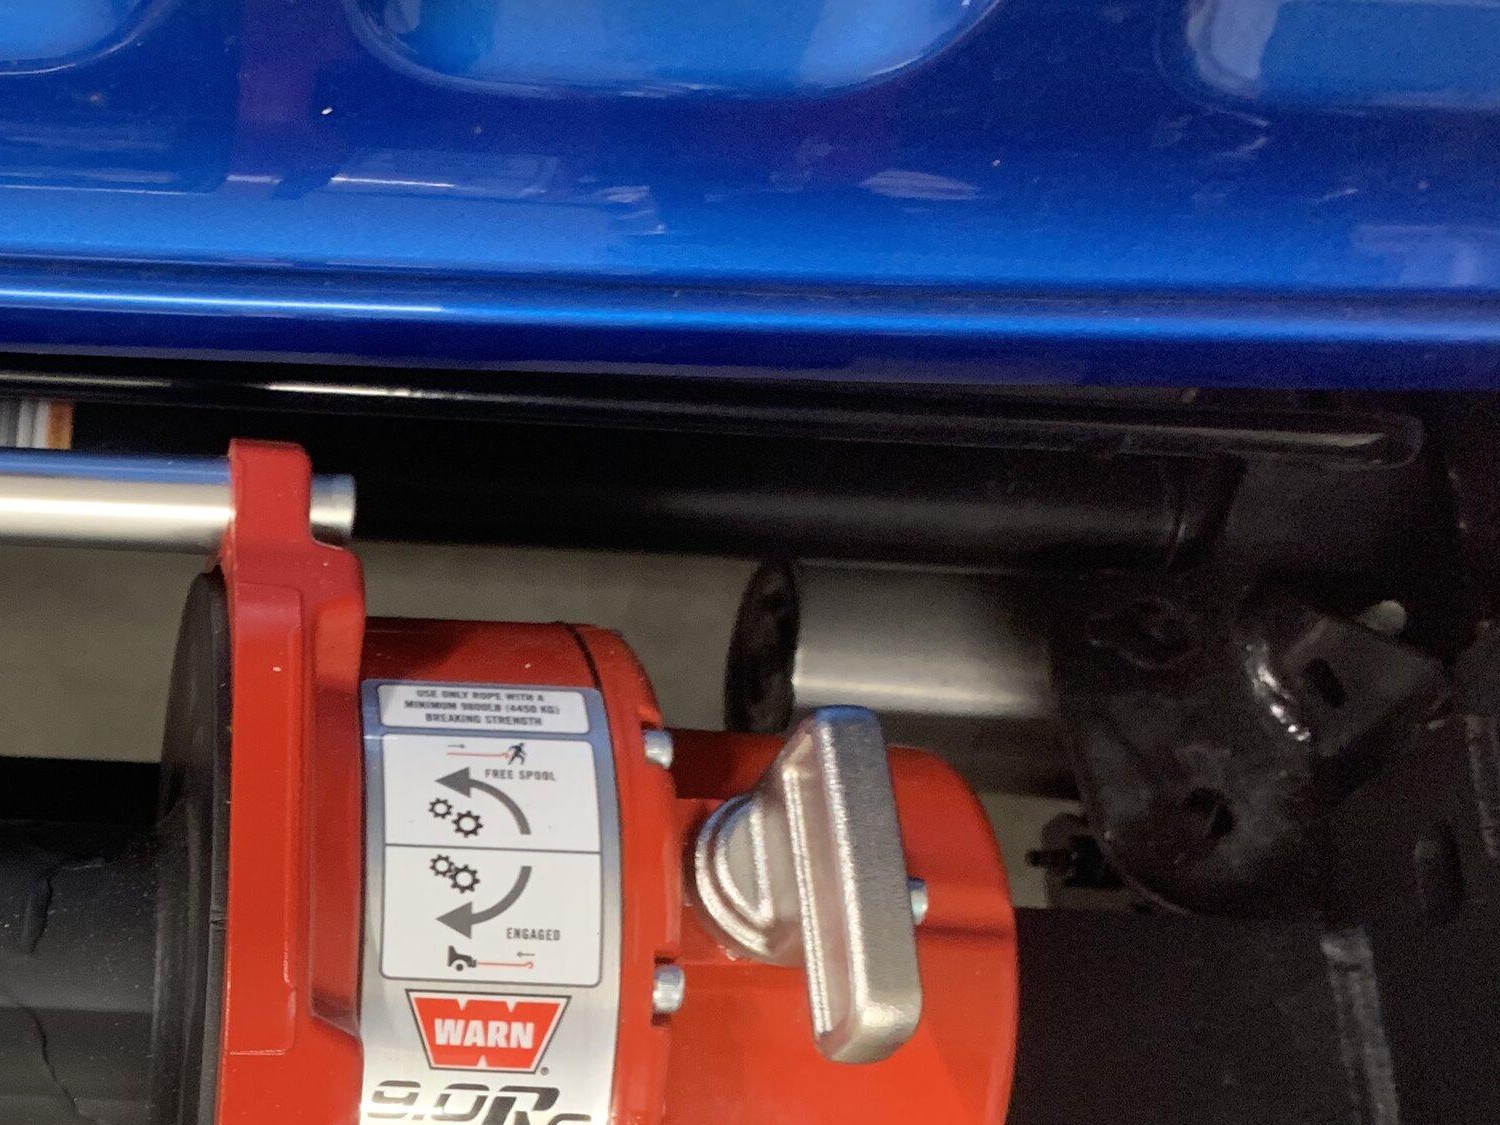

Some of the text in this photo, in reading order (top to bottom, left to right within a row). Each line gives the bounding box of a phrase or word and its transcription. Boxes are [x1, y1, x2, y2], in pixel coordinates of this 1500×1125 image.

[416, 689, 544, 702] USE ONLY ROPE WITH A
[404, 700, 457, 710] MINIMUM
[425, 712, 542, 726] BREAKING STRENGTH
[484, 768, 556, 782] FREE SPOOL
[506, 927, 561, 941] ENGAGED
[433, 1018, 536, 1050] WARN
